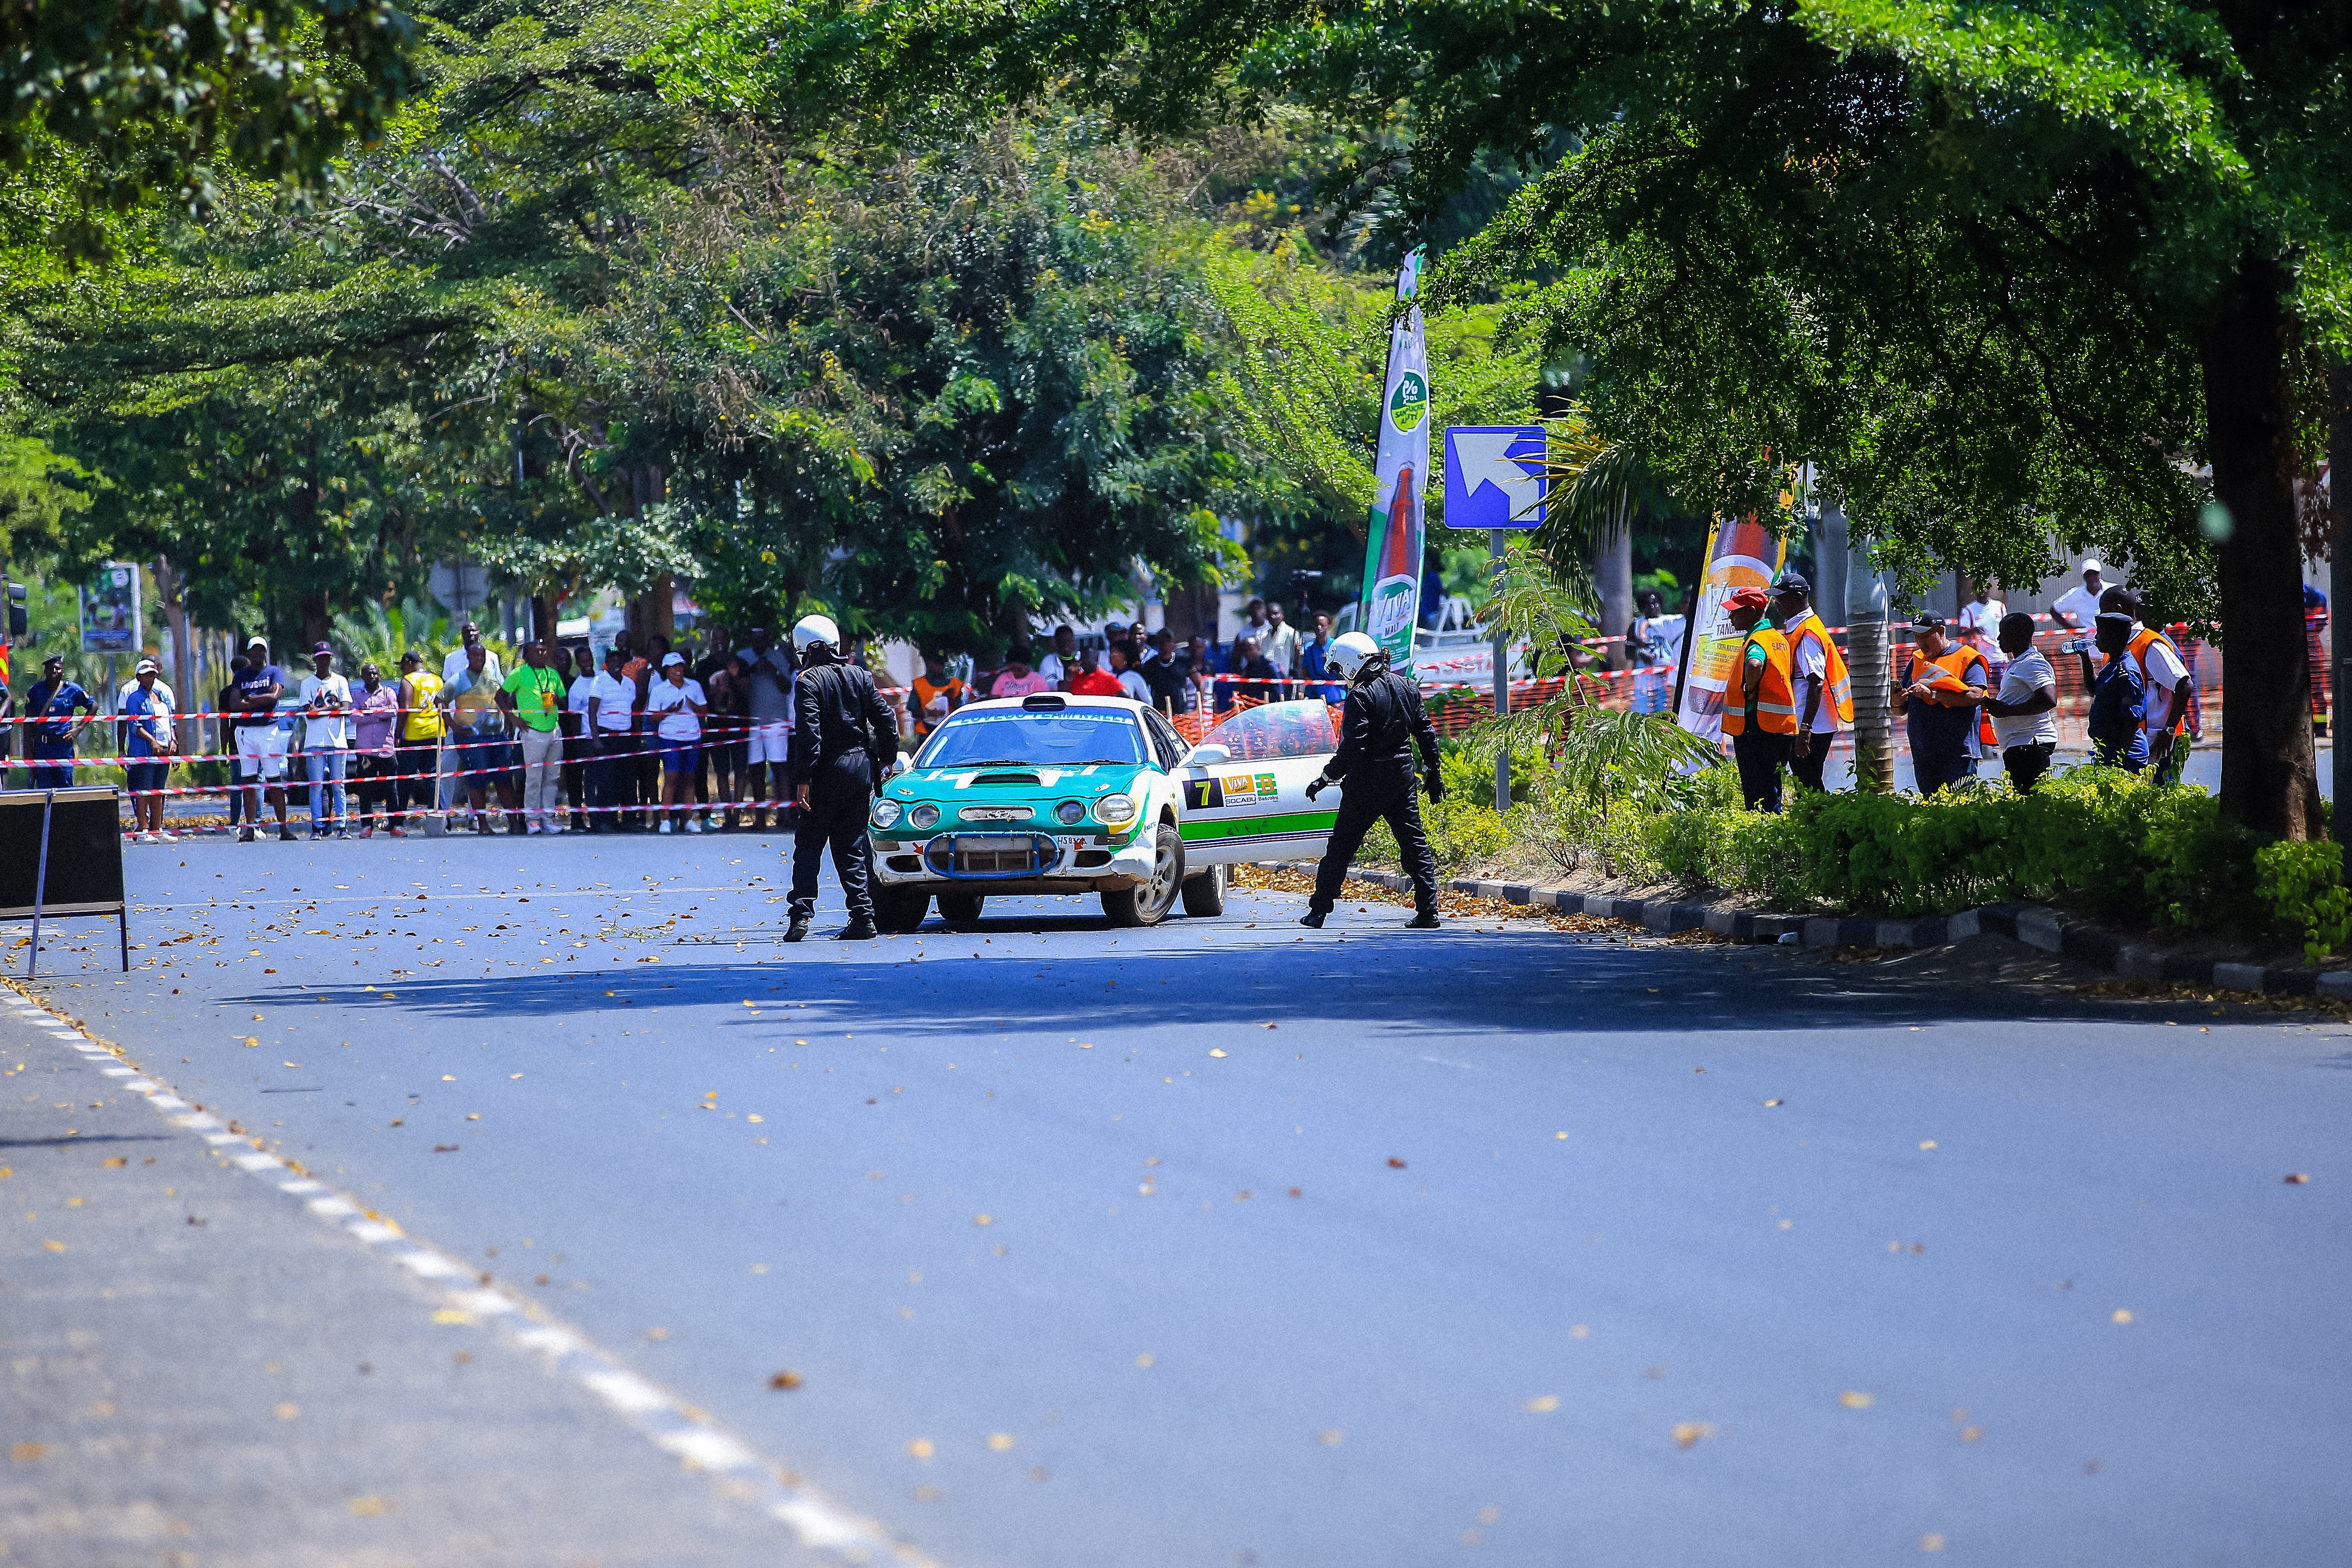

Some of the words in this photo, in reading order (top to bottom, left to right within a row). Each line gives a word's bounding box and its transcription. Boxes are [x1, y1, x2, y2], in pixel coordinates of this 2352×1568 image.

[1375, 588, 1411, 628] VIVA
[1384, 622, 1399, 637] MALT
[1194, 781, 1211, 806] 7
[1225, 776, 1249, 792] VIVA
